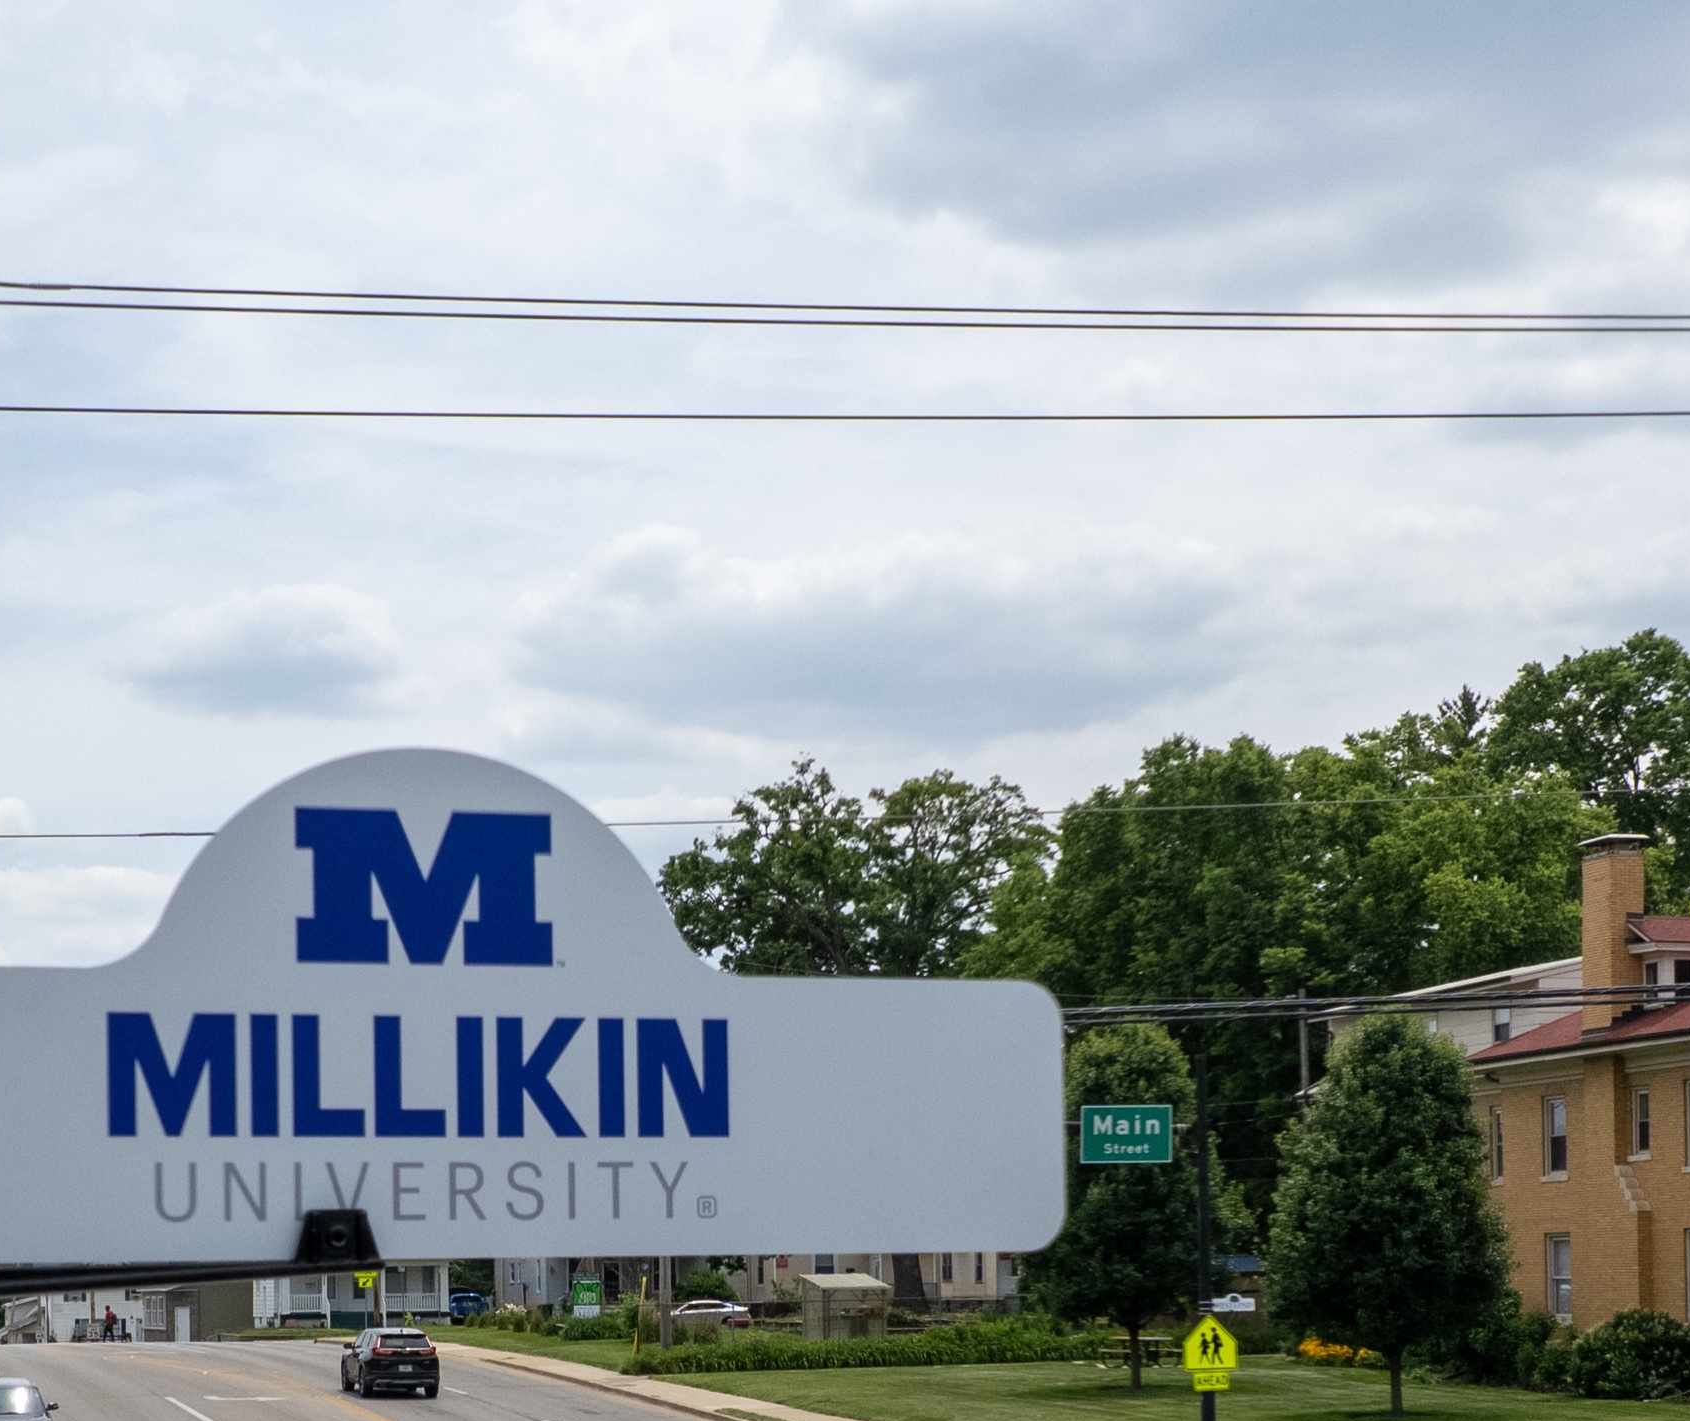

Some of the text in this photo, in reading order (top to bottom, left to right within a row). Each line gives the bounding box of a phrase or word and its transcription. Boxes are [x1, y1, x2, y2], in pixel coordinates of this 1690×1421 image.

[295, 807, 553, 967] M
[106, 1012, 730, 1138] MILLIKIN
[1093, 1114, 1160, 1135] Main
[1103, 1143, 1150, 1154] Street
[1195, 1375, 1228, 1386] AHEAD
